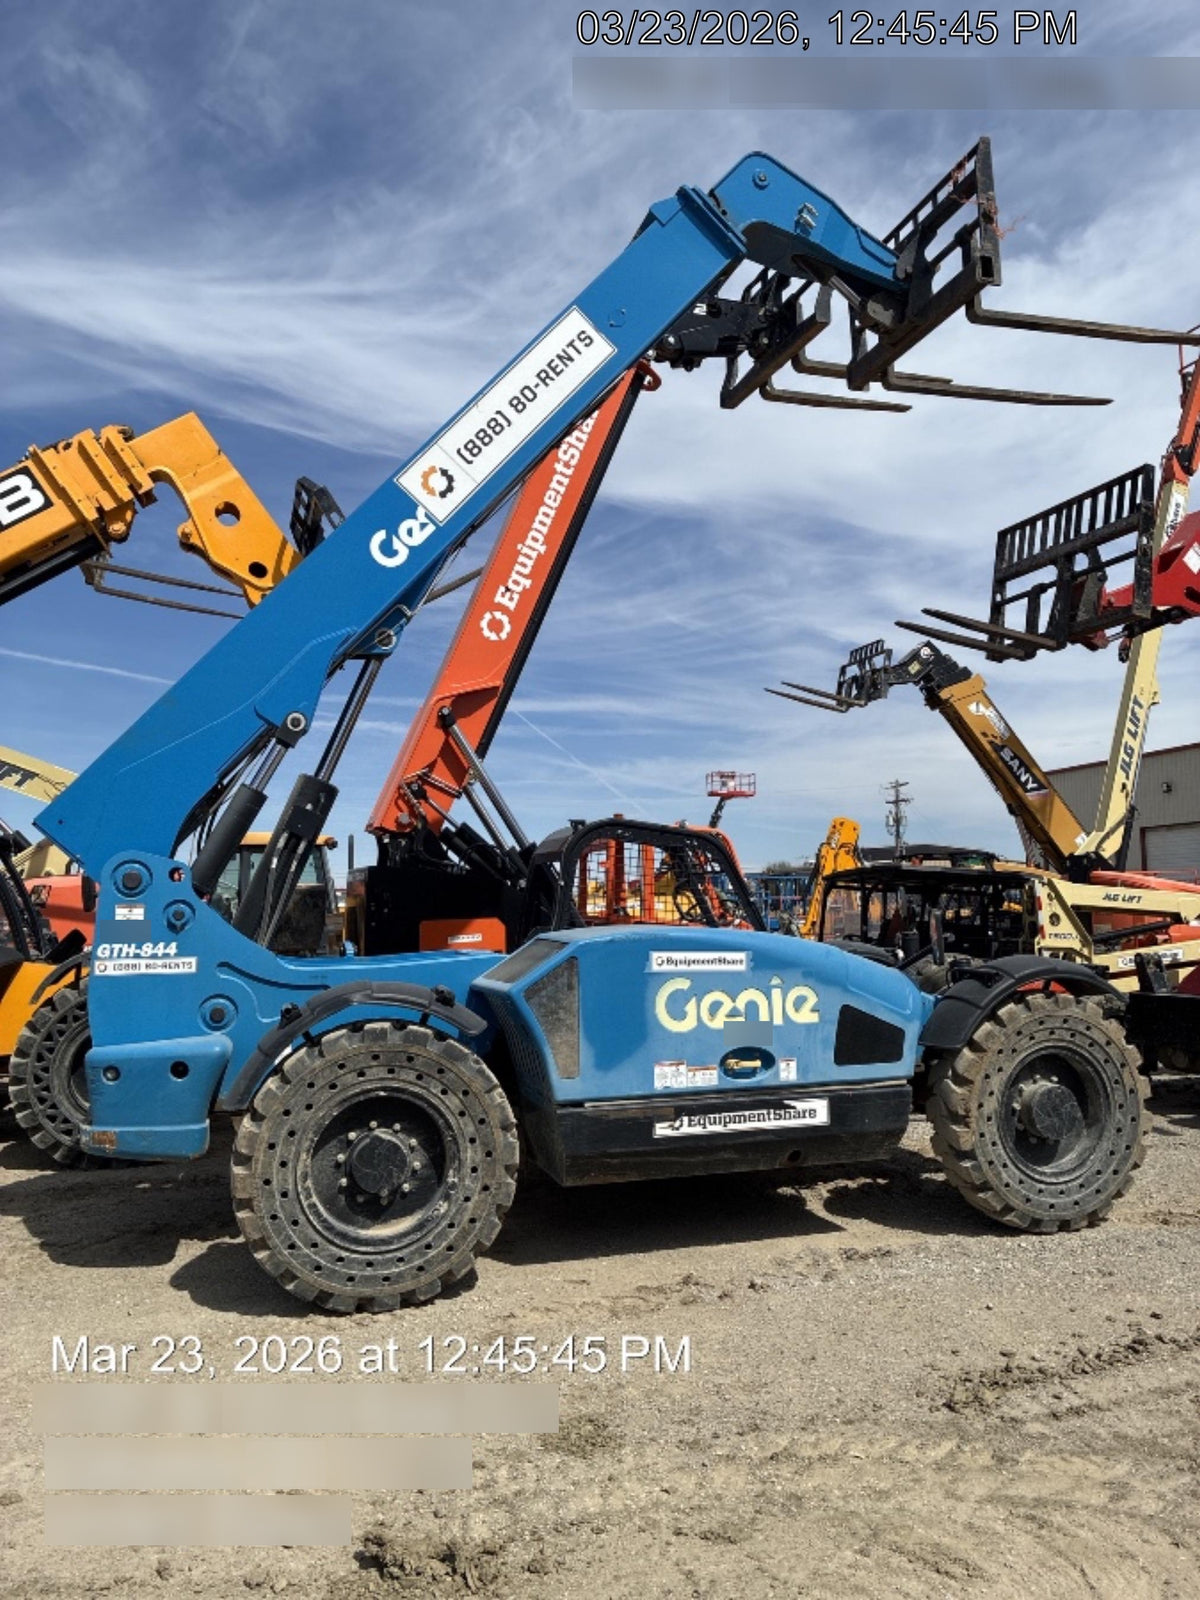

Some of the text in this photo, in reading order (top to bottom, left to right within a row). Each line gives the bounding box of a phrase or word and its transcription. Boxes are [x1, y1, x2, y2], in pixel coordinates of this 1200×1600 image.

[456, 330, 594, 465] (888) 80-RENTS
[494, 409, 600, 612] EquipmentSha
[1120, 694, 1144, 781] JLG LIFT
[1000, 747, 1039, 791] SANY
[1122, 894, 1143, 903] LIFT
[96, 942, 178, 958] GTH-844
[666, 956, 744, 968] EquipmentShare
[655, 974, 820, 1033] Genie
[687, 1107, 817, 1128] EquipmentShare
